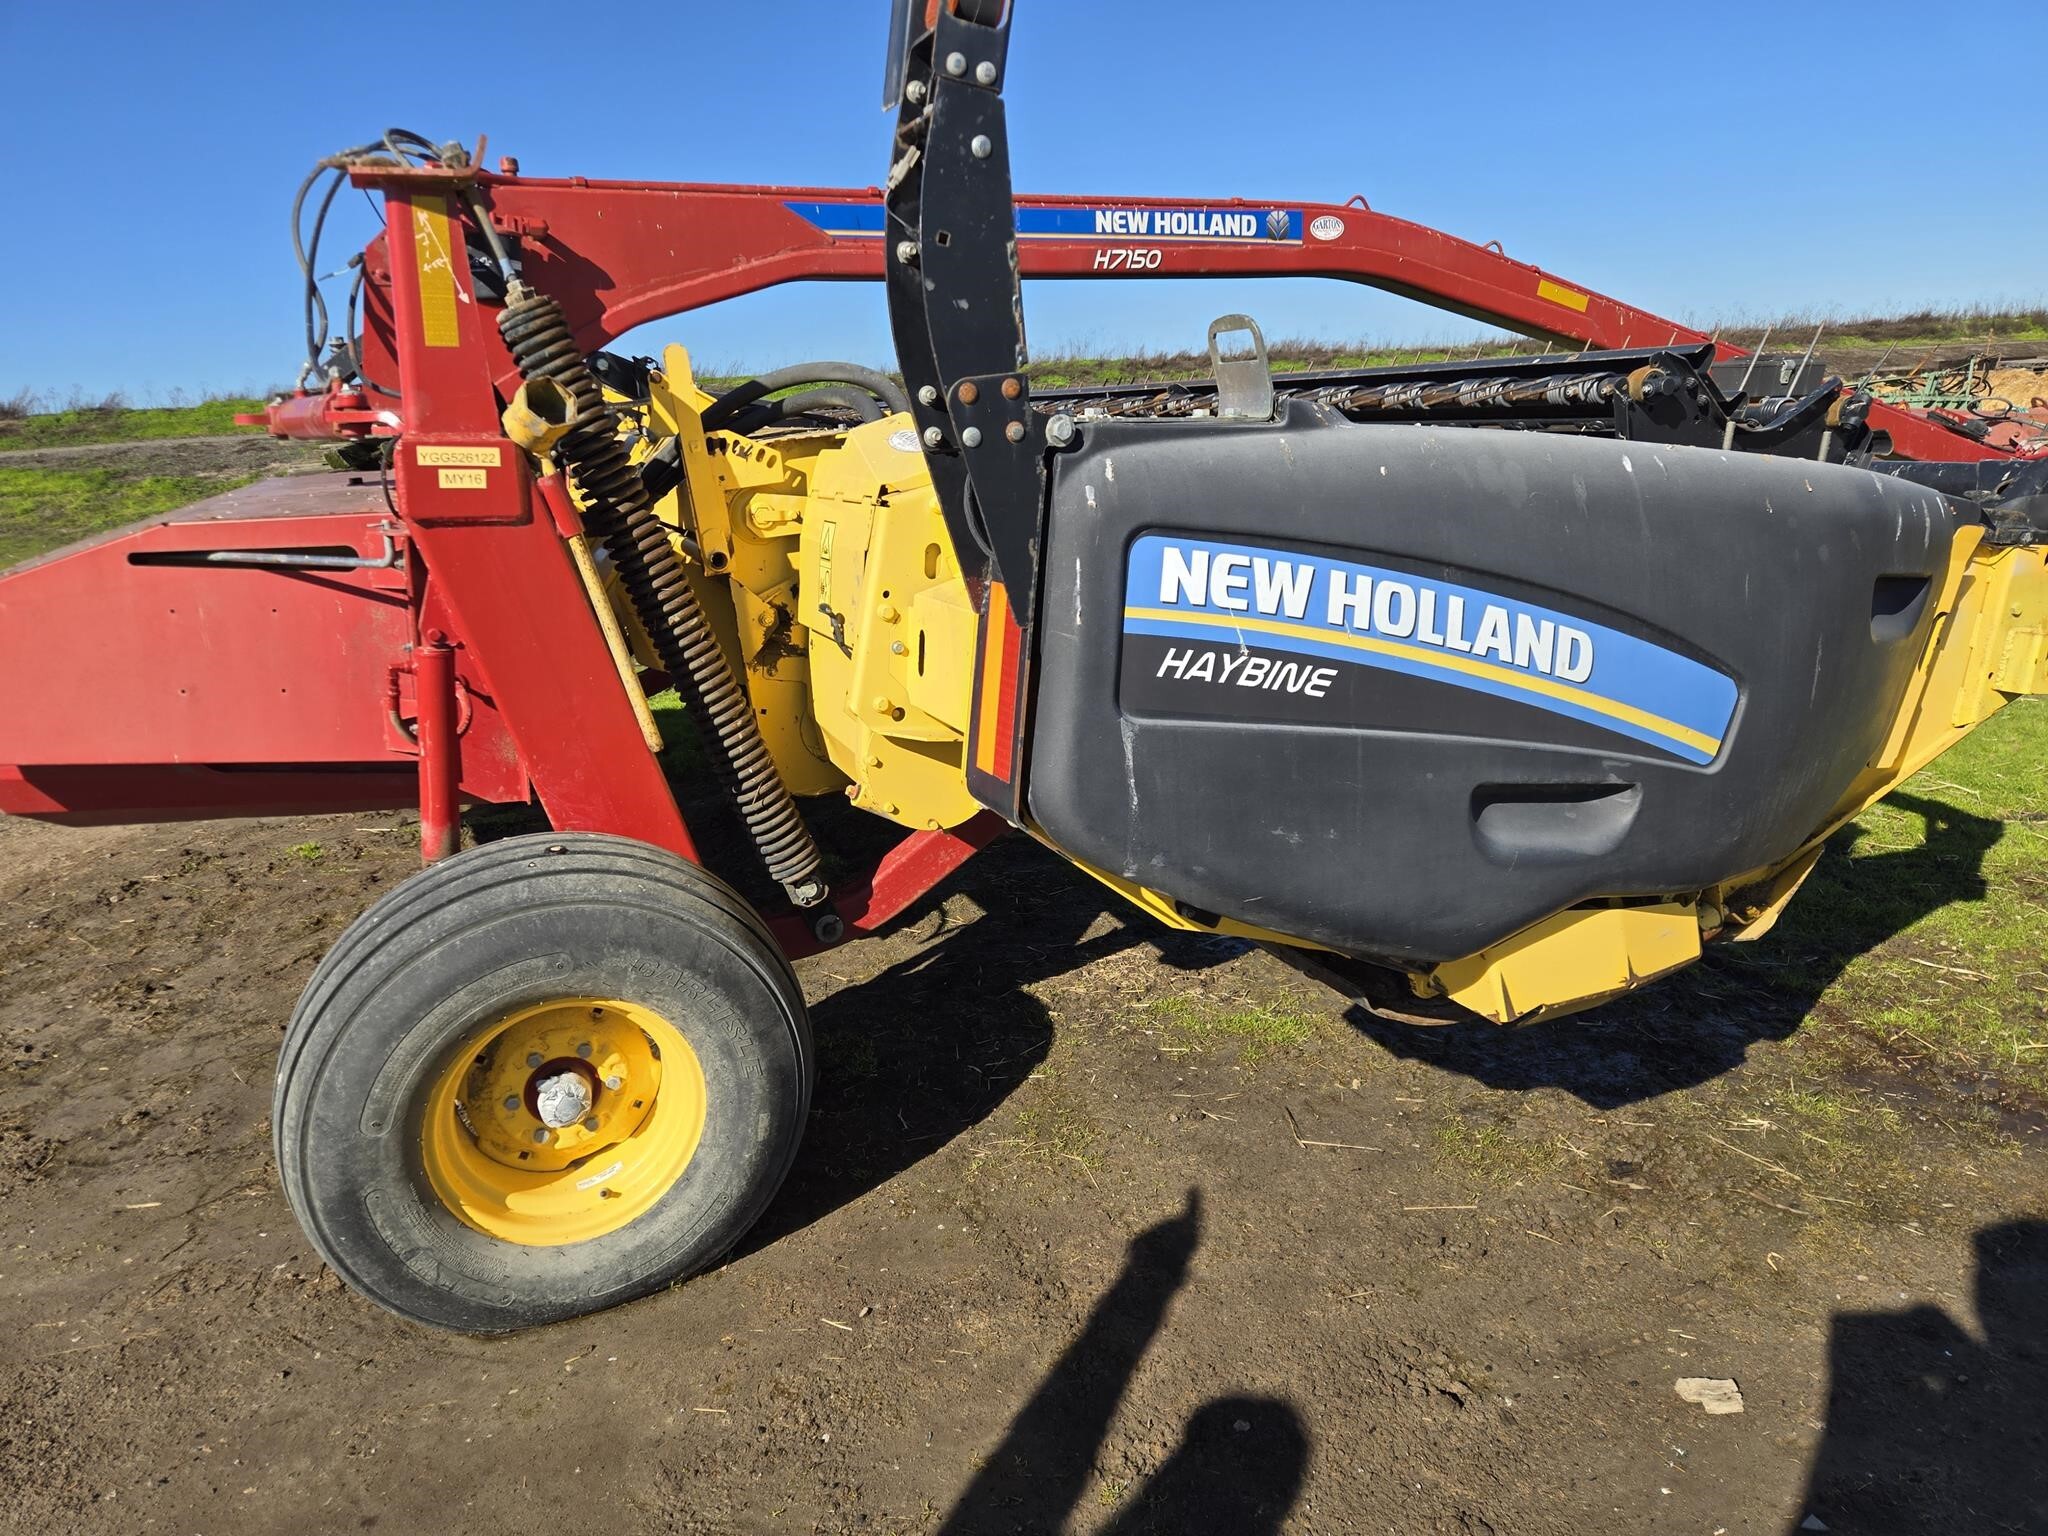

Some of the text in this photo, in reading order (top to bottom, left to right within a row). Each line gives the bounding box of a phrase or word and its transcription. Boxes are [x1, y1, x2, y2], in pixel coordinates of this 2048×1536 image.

[1095, 210, 1257, 237] NEW HOLLAND
[1093, 249, 1163, 270] H7150
[419, 451, 496, 464] YGG526122
[445, 473, 482, 485] MY16
[1160, 546, 1595, 684] NEW HOLLAND
[1156, 647, 1338, 698] HAYBINE
[630, 958, 764, 1080] CARLISLE
